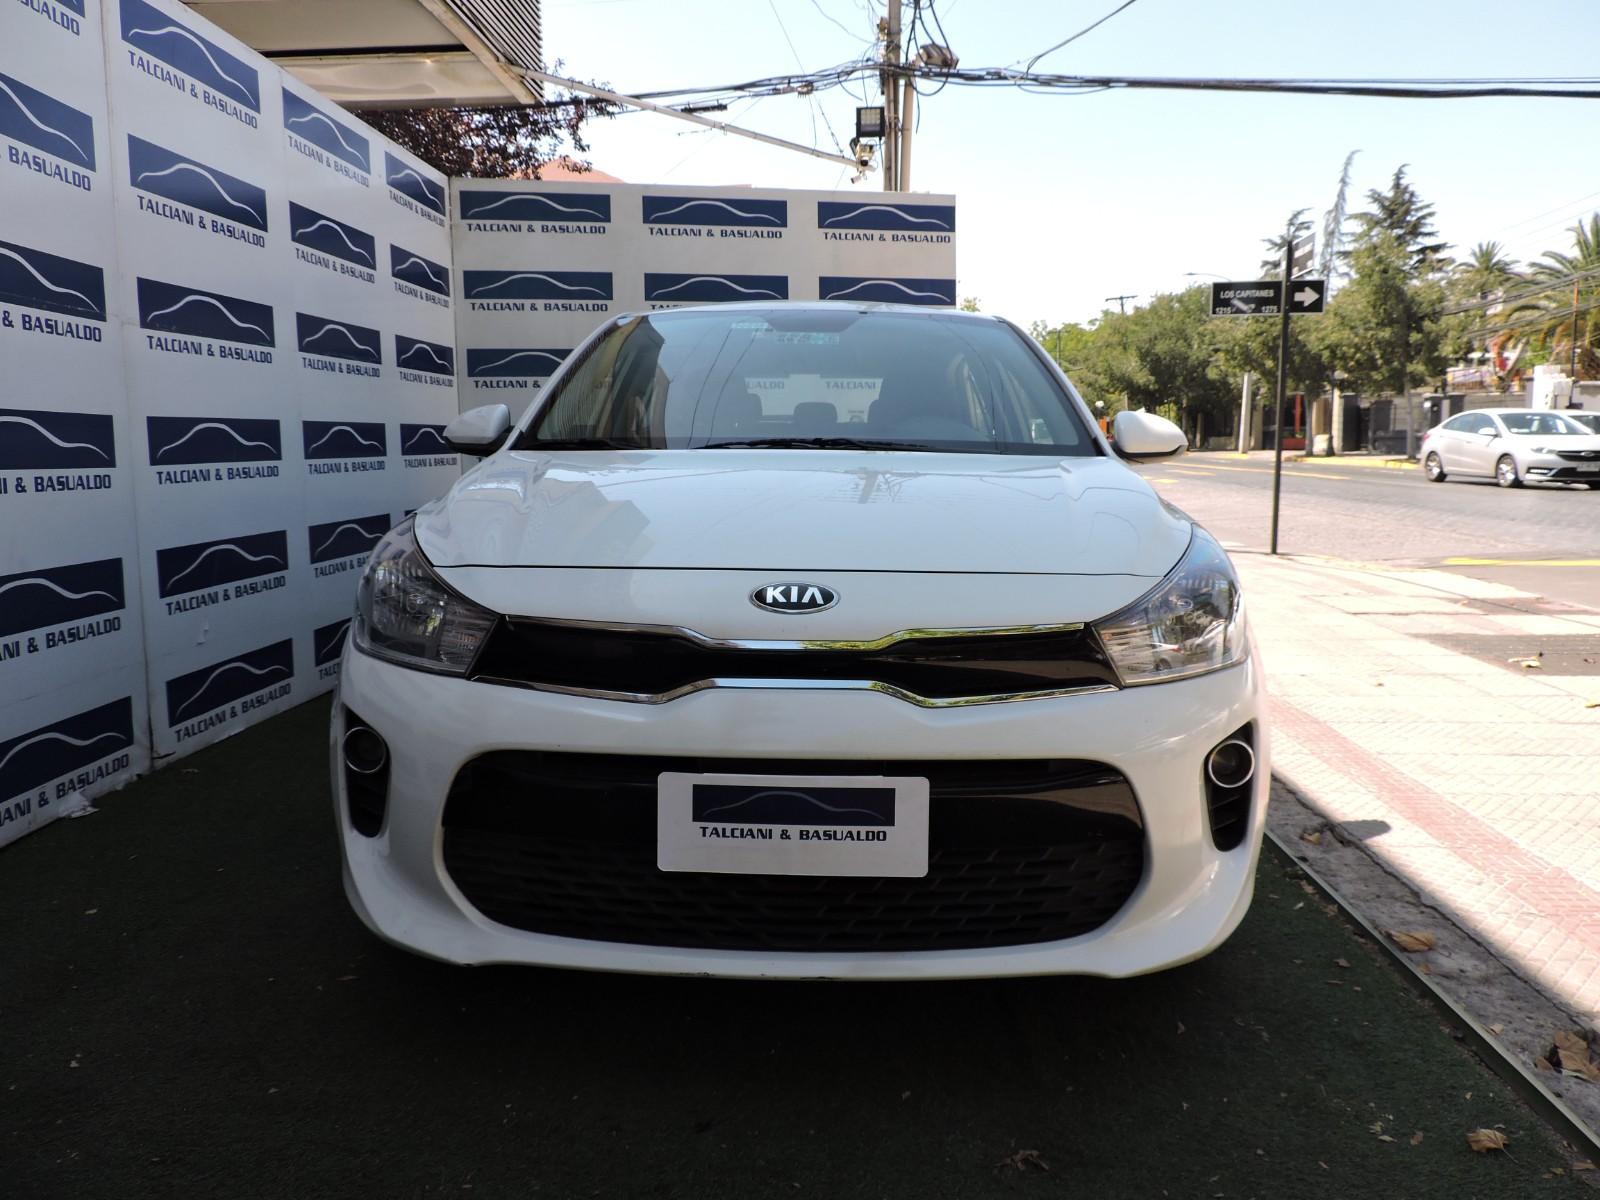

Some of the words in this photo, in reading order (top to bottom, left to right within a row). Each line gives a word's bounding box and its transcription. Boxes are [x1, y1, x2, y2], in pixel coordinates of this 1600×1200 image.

[128, 50, 185, 92] TALCIANI
[190, 83, 198, 99] &
[203, 90, 258, 129] BASUALDO
[8, 145, 91, 191] BASUALDO
[288, 135, 323, 167] TALCIANI
[334, 160, 369, 188] BASUALDO
[137, 194, 193, 226] TALCIANI
[198, 215, 207, 230] &
[211, 220, 265, 248] BASUALDO
[466, 223, 522, 233] TALCIANI
[527, 224, 535, 233] &
[541, 224, 606, 234] BASUALDO
[649, 226, 702, 238] TALCIANI
[706, 228, 715, 238] &
[720, 228, 783, 239] BASUALDO
[823, 231, 874, 242] TALCIANI
[878, 233, 887, 242] &
[892, 233, 951, 244] BASUALDO
[296, 247, 330, 270] TALCIANI
[340, 263, 375, 284] BASUALDO
[1220, 290, 1234, 299] LOS
[1235, 289, 1275, 298] CAPITANES
[470, 302, 525, 311] TALCIANI
[530, 302, 538, 311] &
[544, 303, 608, 312] BASUALDO
[2, 310, 14, 328] &
[22, 313, 102, 342] BASUALDO
[146, 335, 202, 355] TALCIANI
[207, 343, 215, 357] &
[219, 345, 272, 364] BASUALDO
[302, 357, 336, 373] TALCIANI
[346, 363, 380, 378] BASUALDO
[473, 379, 528, 389] TALCIANI
[532, 379, 541, 388] &
[825, 381, 876, 390] TALCIANI
[156, 468, 211, 485] TALCIANI
[215, 468, 223, 481] &
[227, 465, 279, 480] BASUALDO
[307, 462, 341, 475] TALCIANI
[15, 477, 27, 493] &
[34, 474, 111, 492] BASUALDO
[314, 561, 347, 578] TALCIANI
[165, 591, 219, 616] TALCIANI
[223, 588, 231, 602] &
[235, 575, 286, 598] BASUALDO
[765, 585, 825, 605] KIA
[27, 637, 39, 654] &
[45, 616, 121, 649] BASUALDO
[174, 710, 226, 743] TALCIANI
[230, 705, 238, 719] &
[241, 683, 291, 714] BASUALDO
[38, 791, 49, 808] &
[56, 753, 129, 800] BASUALDO
[699, 826, 773, 840] TALCIANI
[780, 828, 792, 840] &
[799, 829, 887, 842] BASUALDO
